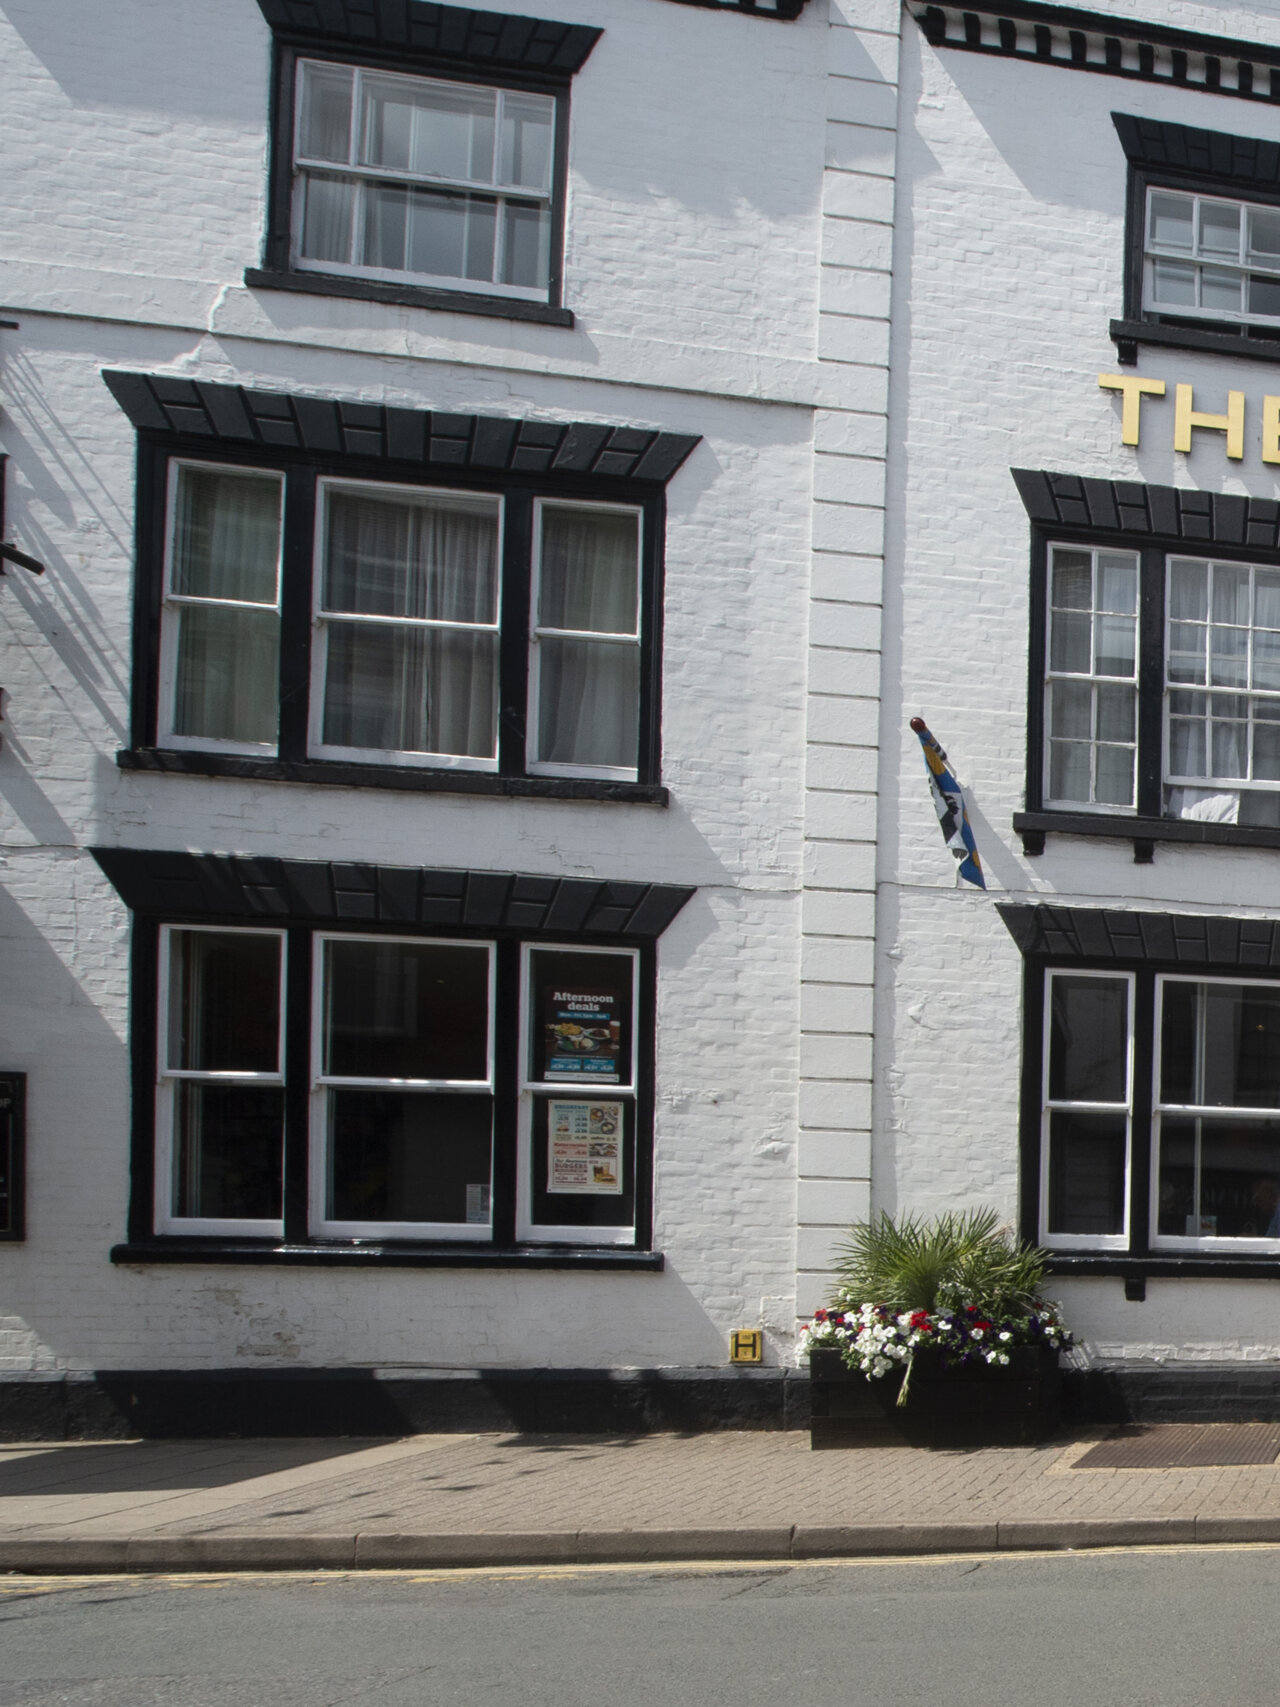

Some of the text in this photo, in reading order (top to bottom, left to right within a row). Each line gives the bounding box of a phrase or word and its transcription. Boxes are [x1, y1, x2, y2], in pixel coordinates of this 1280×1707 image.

[552, 991, 614, 1003] Afternoon
[567, 1002, 600, 1012] deals
[735, 1333, 757, 1358] H
